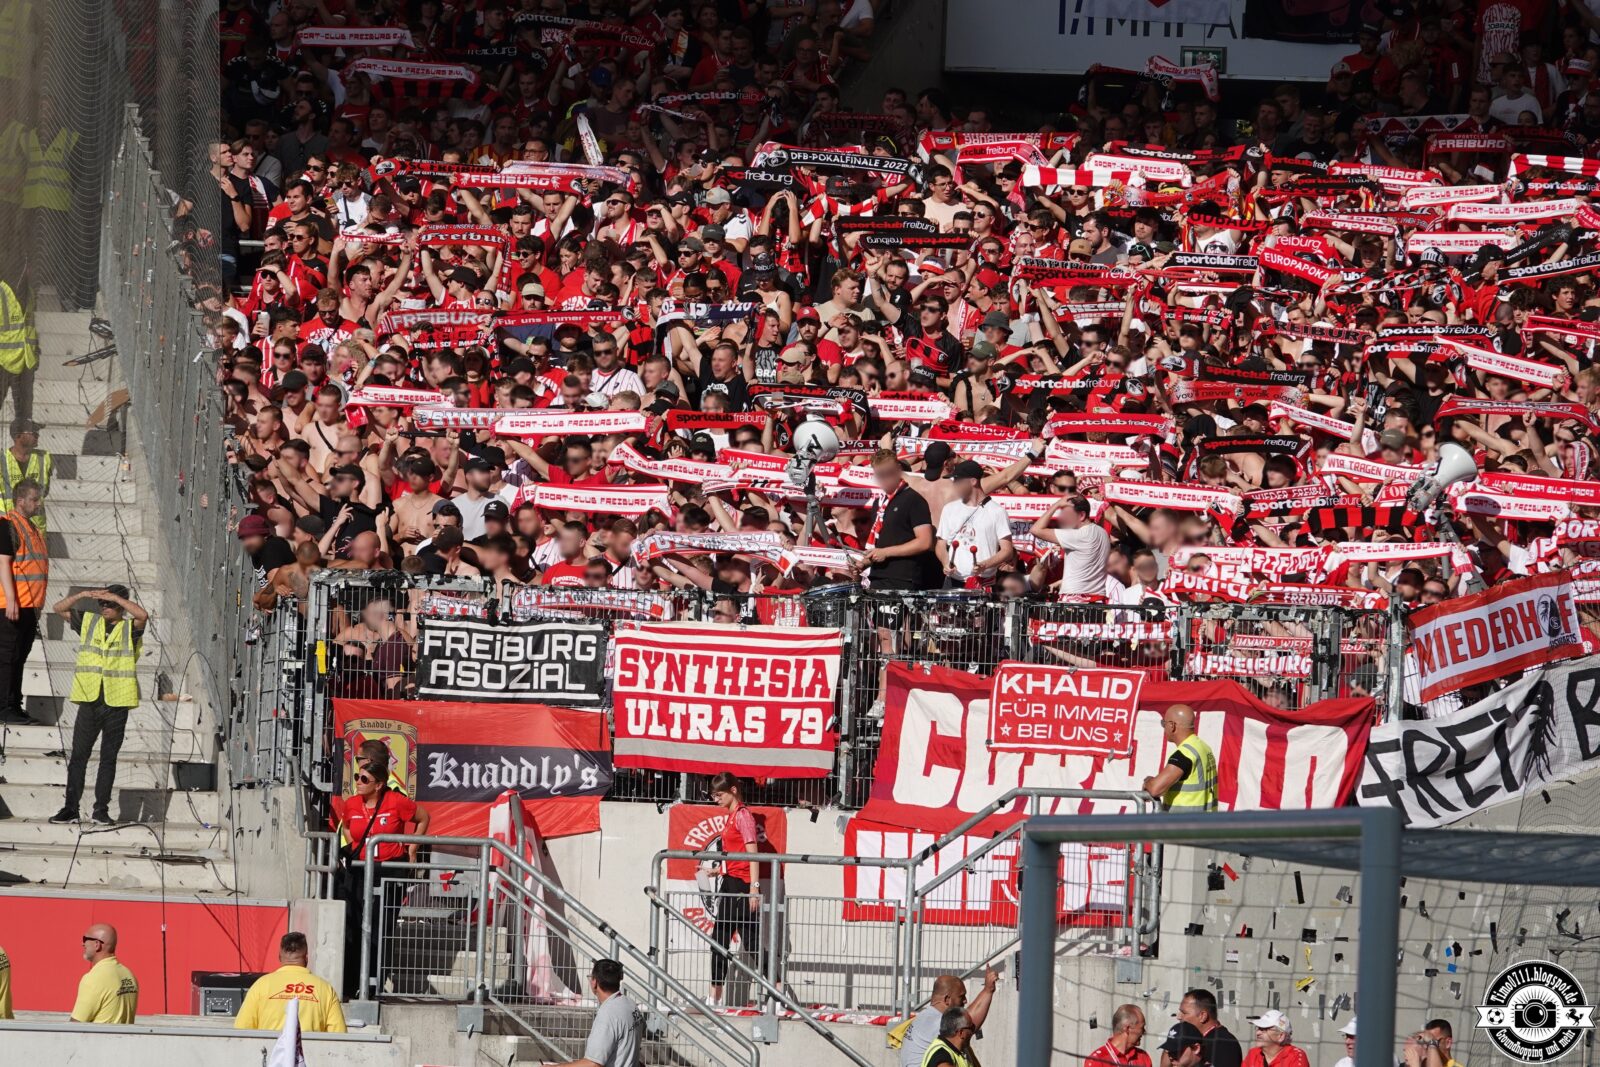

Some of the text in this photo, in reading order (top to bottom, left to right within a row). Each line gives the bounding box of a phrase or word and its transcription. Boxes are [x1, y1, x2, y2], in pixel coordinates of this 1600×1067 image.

[1437, 139, 1506, 149] FREIBURG
[790, 152, 908, 170] DFB-POKALFINALE 2022
[471, 174, 549, 186] FREIBURG
[1341, 167, 1415, 180] FREIBURG
[1454, 186, 1496, 198] FREIBURG
[1457, 205, 1510, 214] SPORT-CLUB
[1513, 204, 1556, 214] FREIBURG
[1276, 235, 1322, 251] reiburg
[1454, 238, 1495, 247] FREIBURG
[1263, 252, 1331, 281] EUROPAPOKA
[497, 317, 516, 326] Für
[521, 316, 541, 324] uns
[547, 314, 584, 322] immer
[1494, 358, 1535, 374] FREIBURG
[398, 394, 442, 403] FREIBURG
[873, 404, 917, 413] FREIBURG
[509, 420, 565, 428] SPORT-CLUB
[567, 418, 612, 427] FREIBURG
[676, 411, 768, 425] sportclubfreiburg
[1320, 417, 1354, 432] FREIBUR
[662, 463, 705, 476] FREIBURG
[1328, 458, 1345, 468] WIR
[1349, 461, 1382, 477] TRAGEN
[1384, 470, 1406, 481] DICH
[538, 491, 647, 506] SPORT-CLUB FREIBURG
[1119, 487, 1169, 499] SPORT-CLUB
[1172, 493, 1211, 503] FREIBURG
[1024, 502, 1051, 511] FREIB
[1514, 504, 1551, 513] FREIBURG
[1393, 542, 1441, 551] FREIBURG
[1037, 622, 1173, 642] CORRILL
[1203, 654, 1313, 674] FREIBURG
[618, 647, 831, 699] SYNTHESIA
[1001, 672, 1133, 700] KHALID
[999, 698, 1129, 723] FÜR IMMER
[624, 698, 824, 745] ULTRAS 79
[1017, 723, 1108, 742] BEI UNS
[428, 751, 600, 795] Knaddly's
[285, 983, 315, 994] SDS
